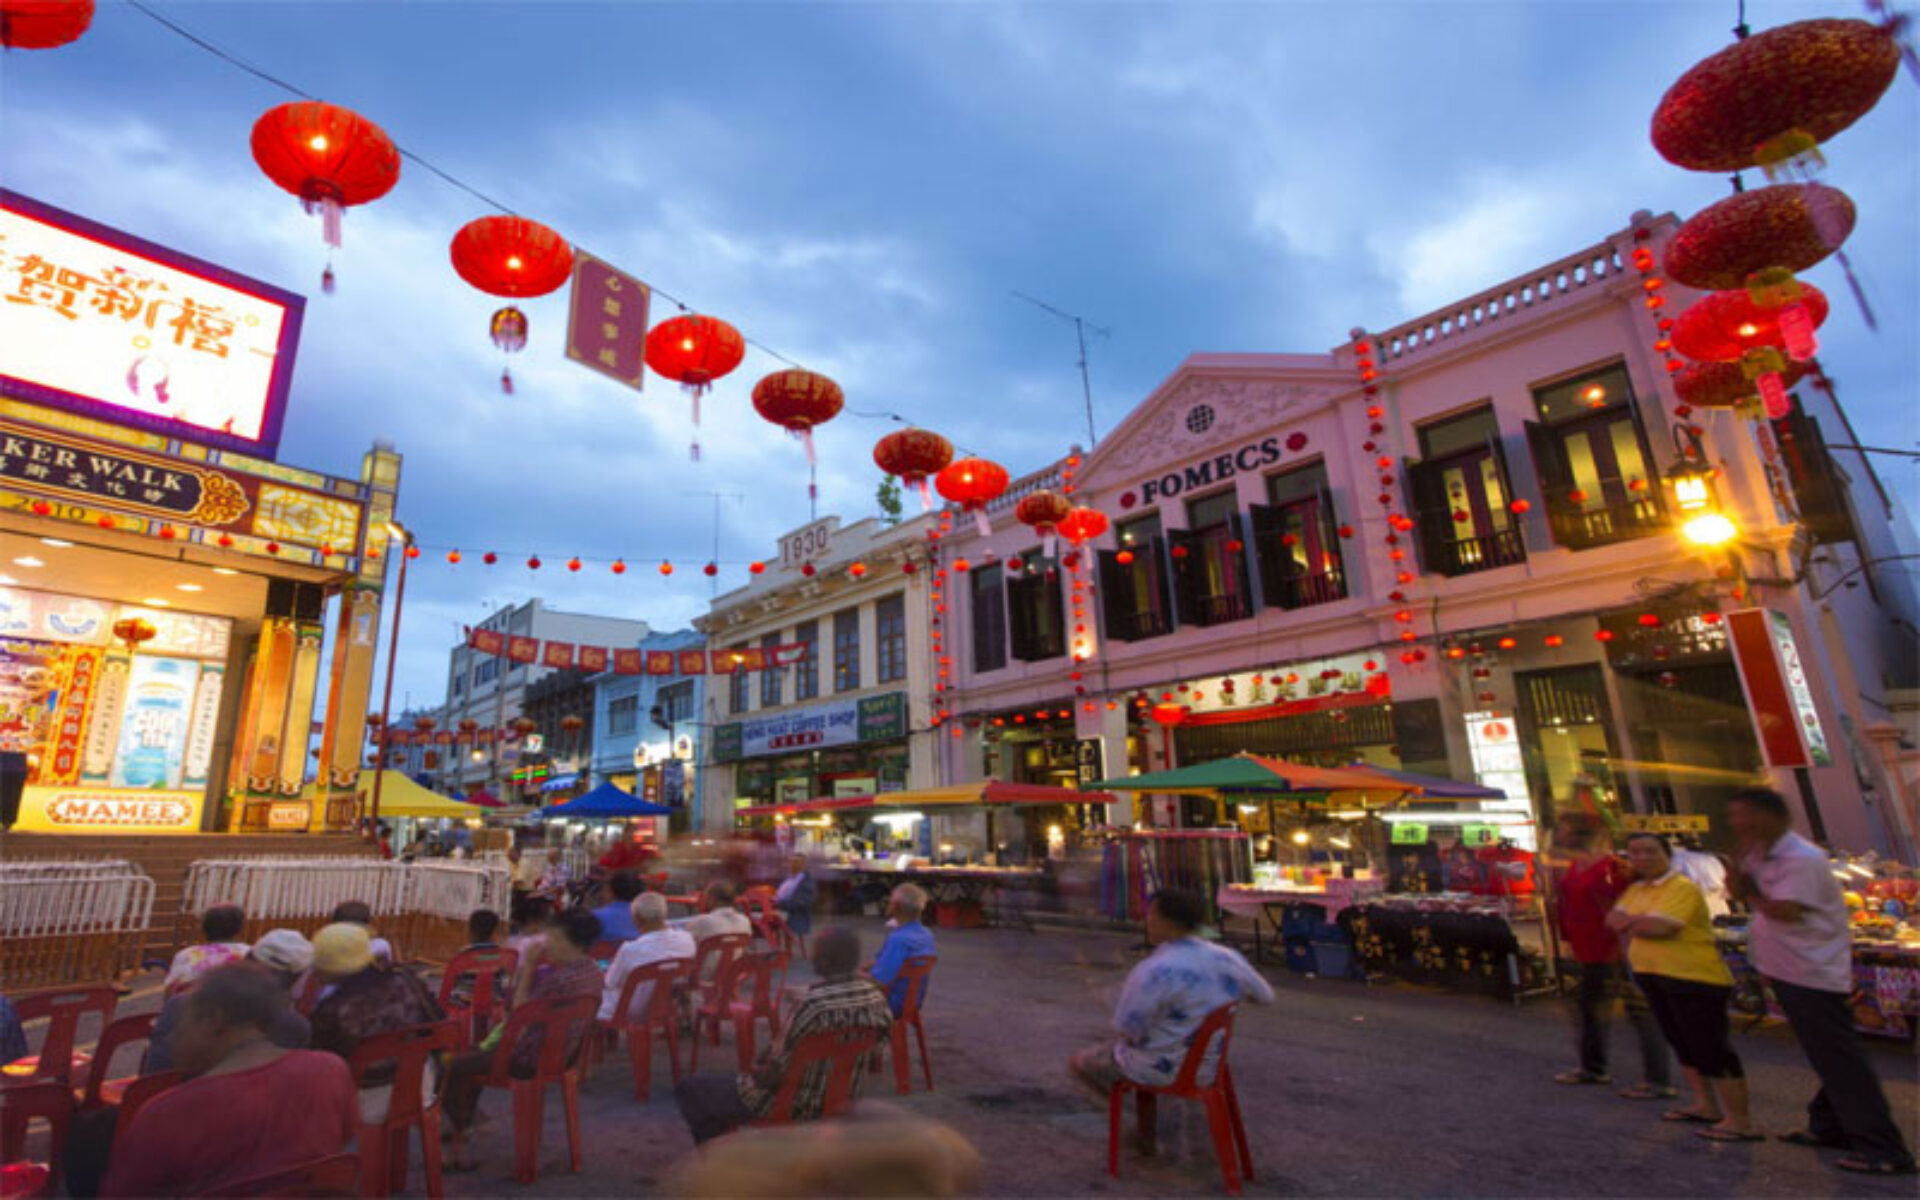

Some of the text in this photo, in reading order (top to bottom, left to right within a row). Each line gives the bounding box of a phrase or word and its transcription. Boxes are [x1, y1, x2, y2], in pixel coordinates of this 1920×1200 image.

[0, 254, 236, 359] 賀新禧
[89, 455, 183, 491] WALK
[1142, 438, 1281, 504] FOMECS
[12, 497, 87, 520] 210
[783, 525, 827, 562] 1930
[791, 714, 827, 733] COFFEE
[828, 709, 856, 728] SHOP
[66, 802, 177, 818] MAMEE
